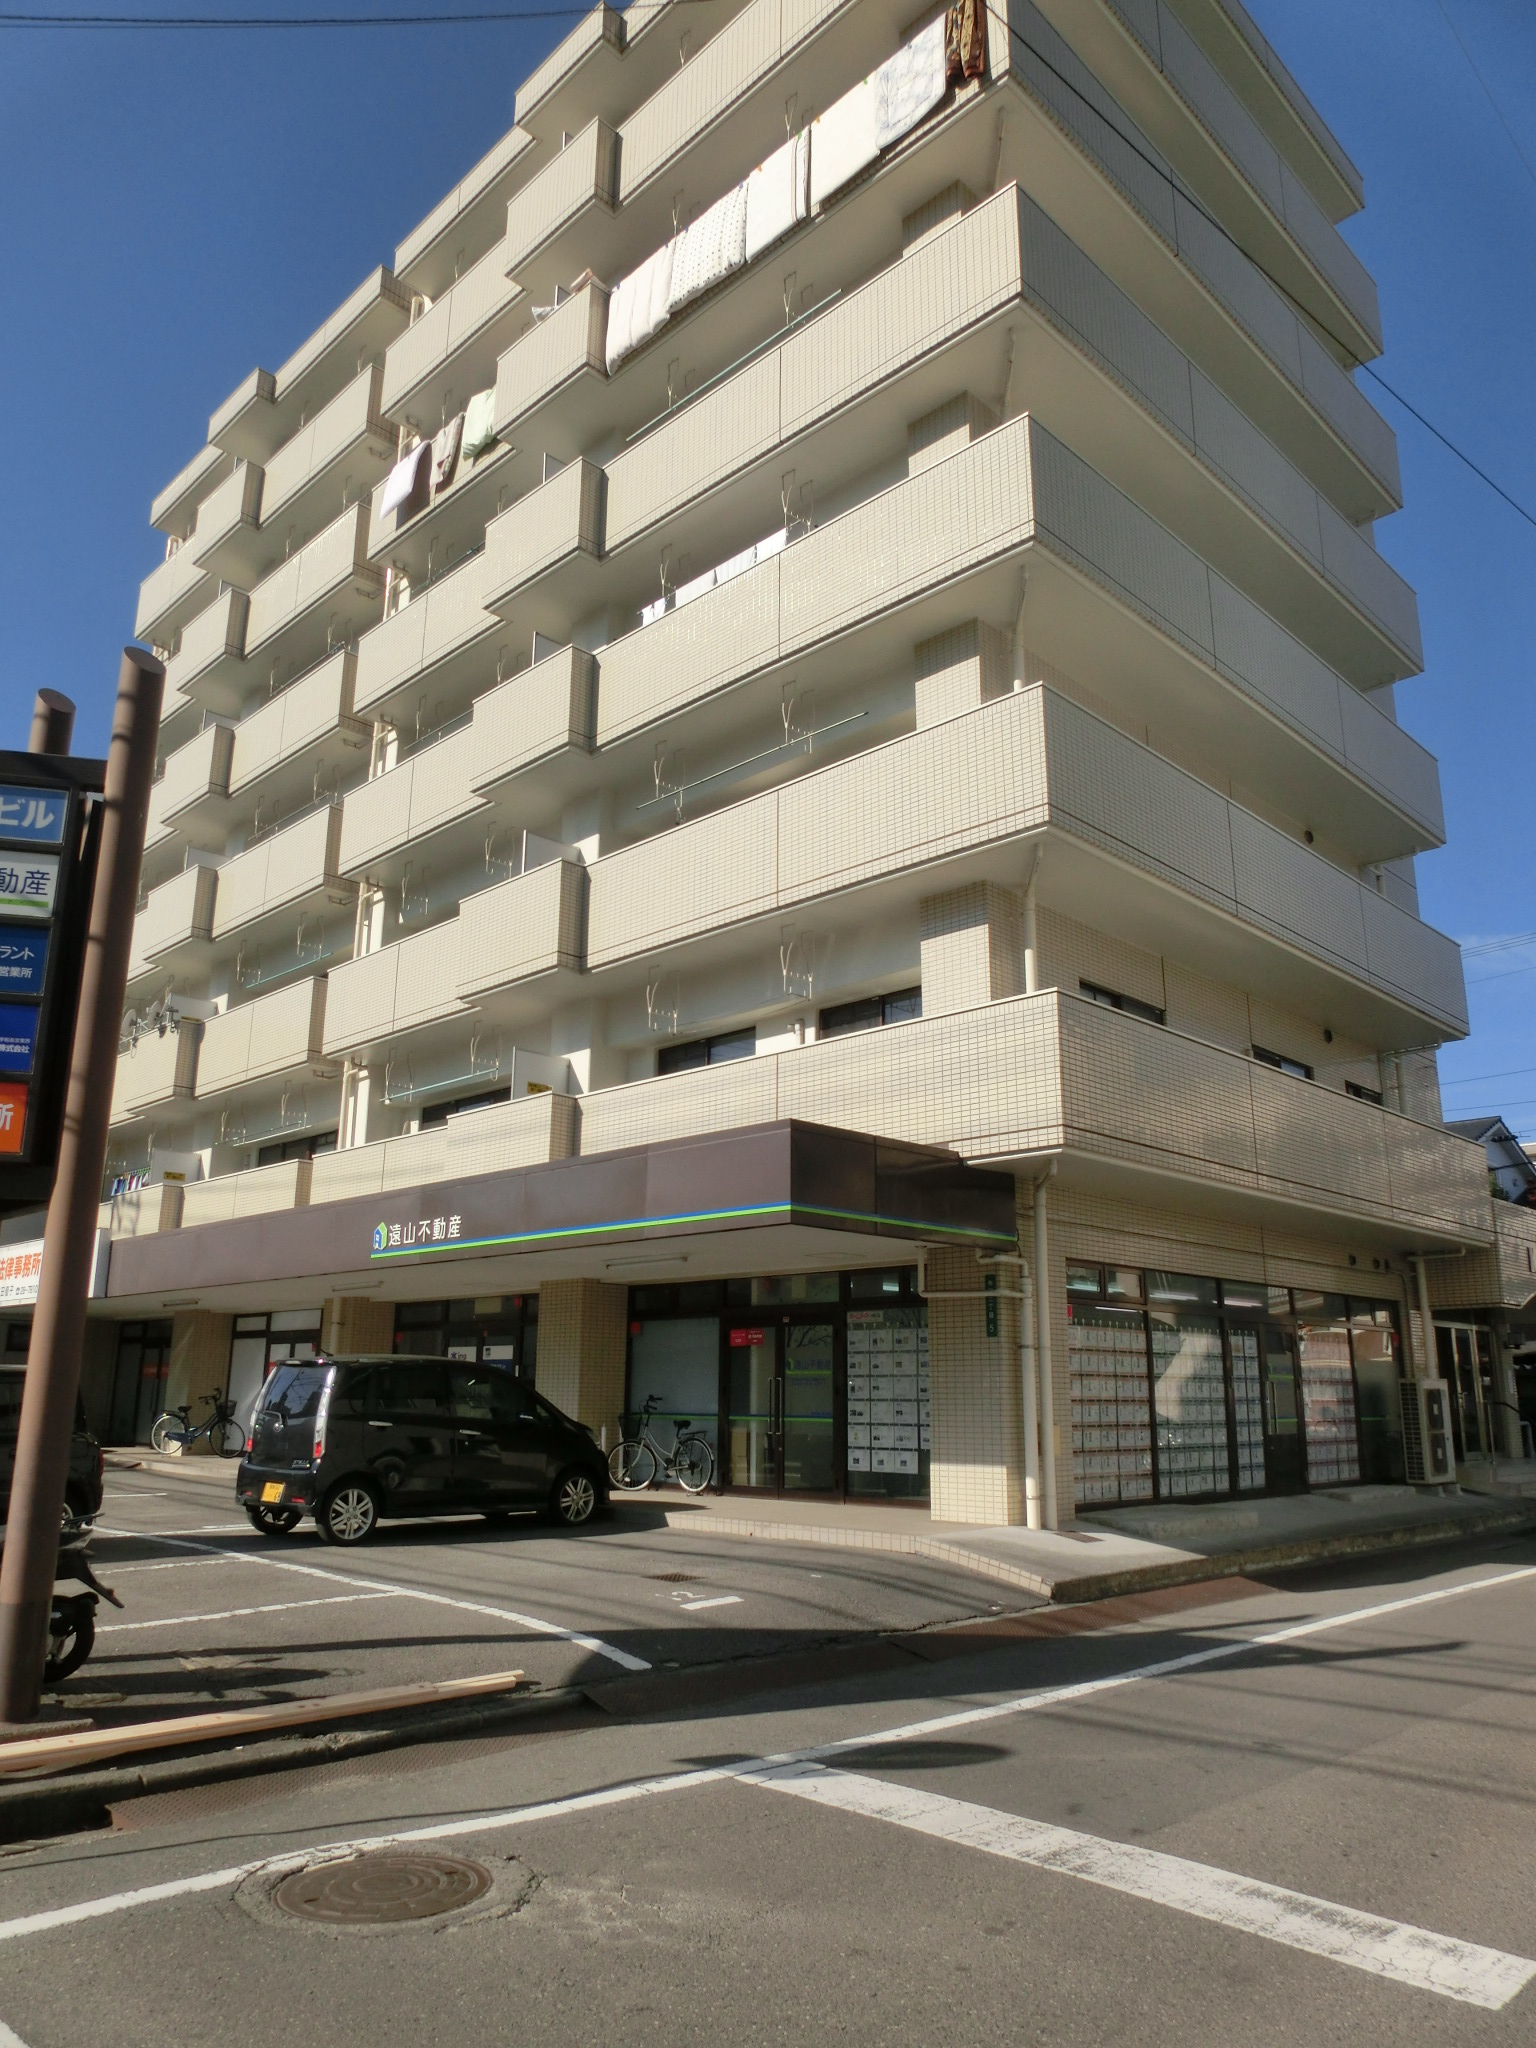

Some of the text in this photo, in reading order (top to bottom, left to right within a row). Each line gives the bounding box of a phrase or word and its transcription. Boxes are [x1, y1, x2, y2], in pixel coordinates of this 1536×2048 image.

[388, 1214, 462, 1247] 遠山不動産
